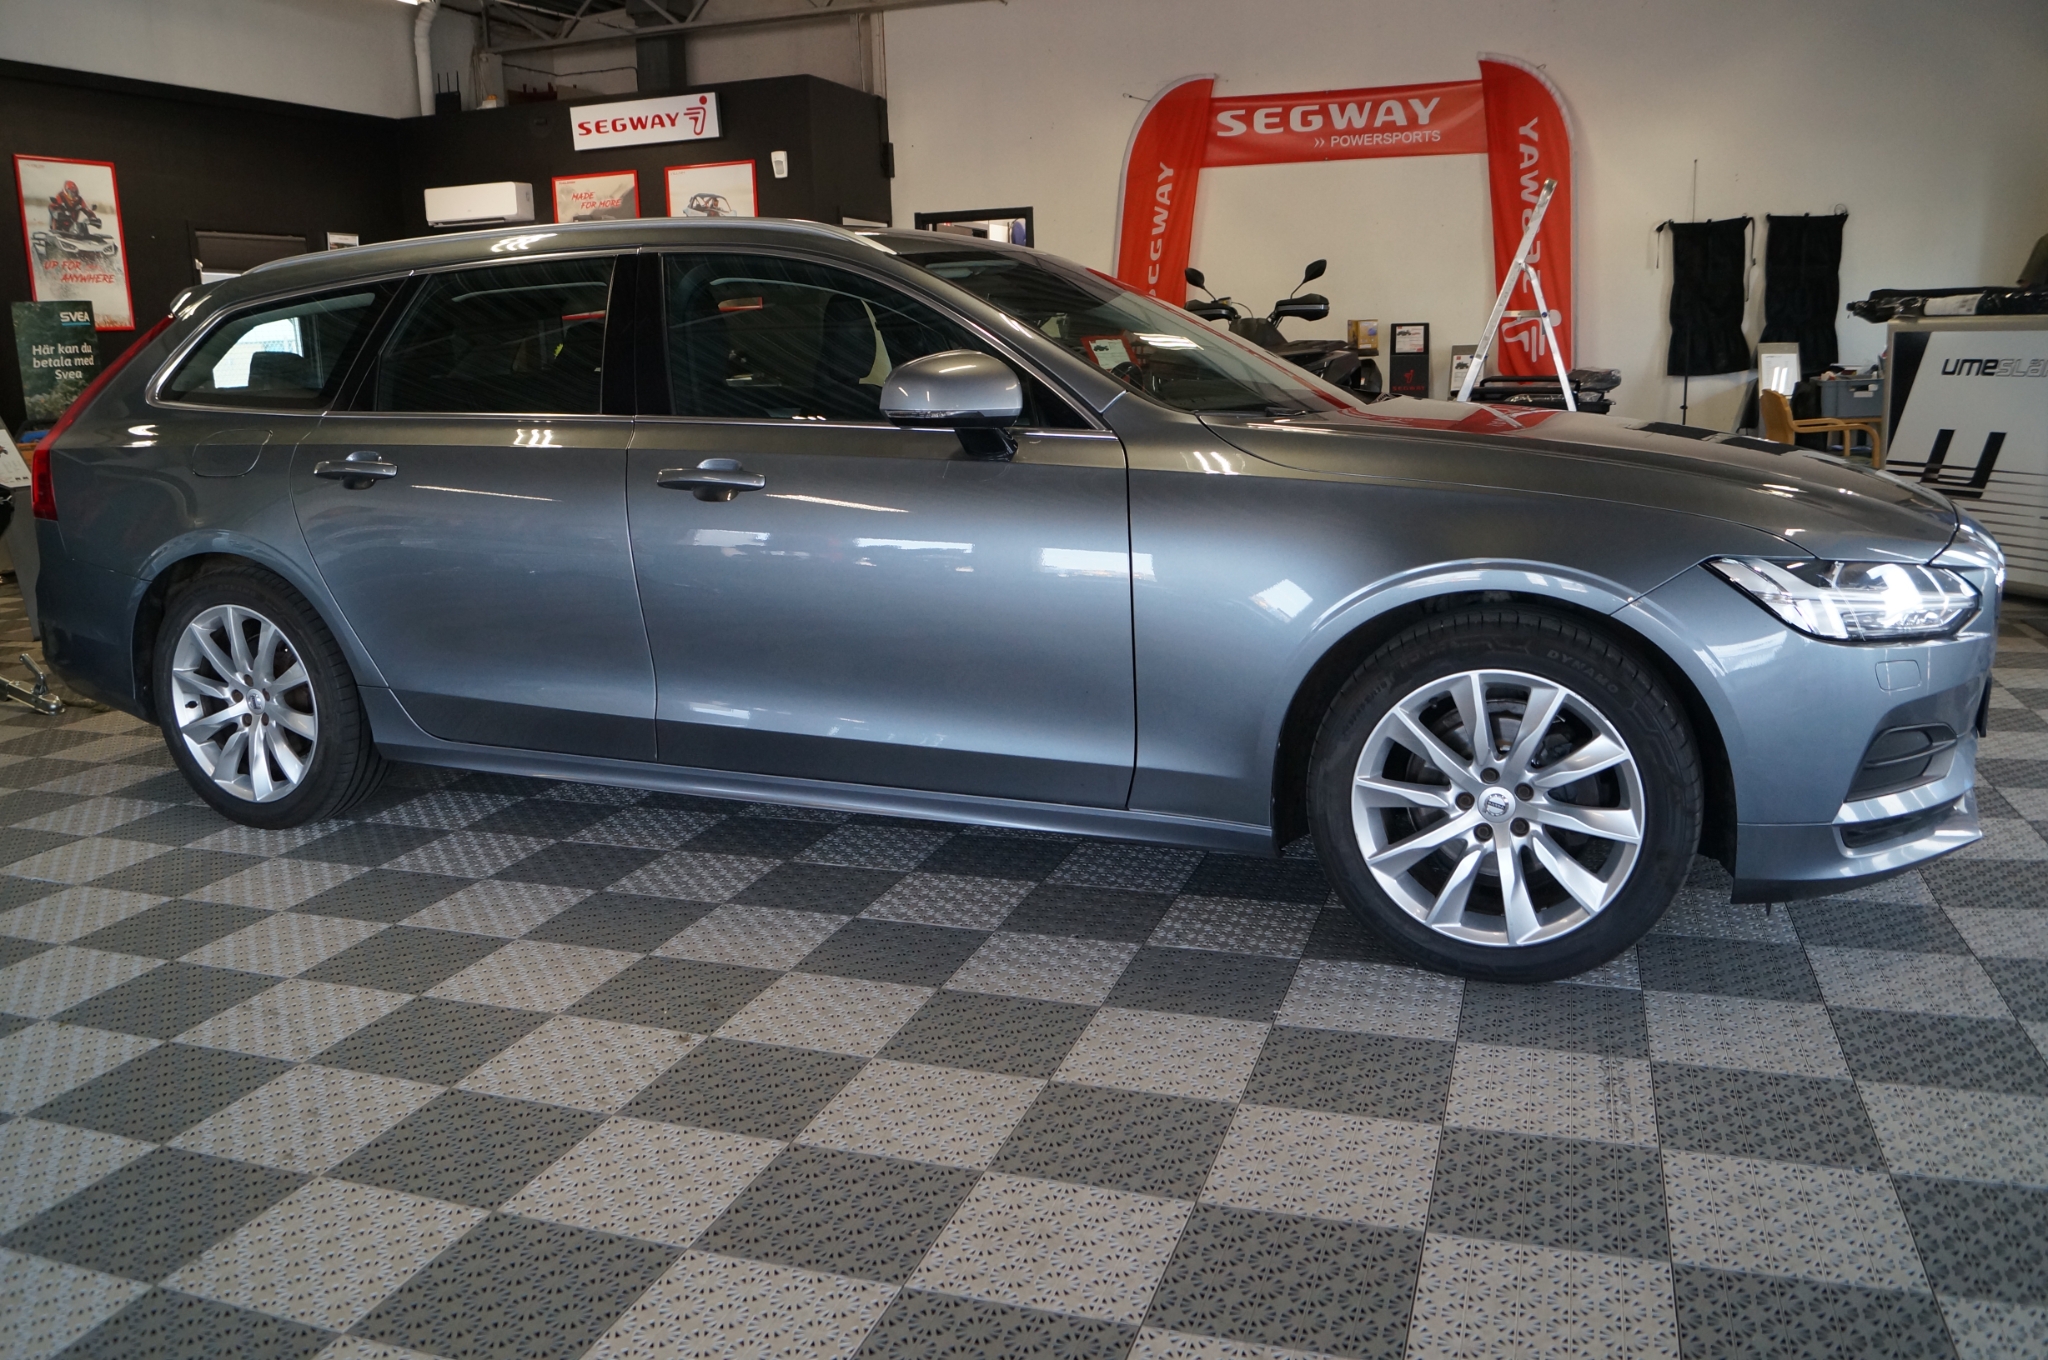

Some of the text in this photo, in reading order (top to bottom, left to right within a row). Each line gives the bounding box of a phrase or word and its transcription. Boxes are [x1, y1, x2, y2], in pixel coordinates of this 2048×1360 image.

[1216, 97, 1441, 137] SEGWAY
[577, 112, 679, 136] SEGWAY
[1330, 130, 1441, 148] POWERSPORTS
[572, 192, 595, 201] MADE
[581, 199, 621, 210] FOR MORE
[44, 260, 58, 270] UP
[61, 261, 81, 271] FOR
[61, 274, 115, 284] ANYWHERE
[60, 311, 90, 322] SVEA
[32, 342, 92, 356] Här kan du
[32, 354, 94, 368] betala med
[55, 369, 83, 380] Svea
[1546, 649, 1619, 694] DYNAMO
